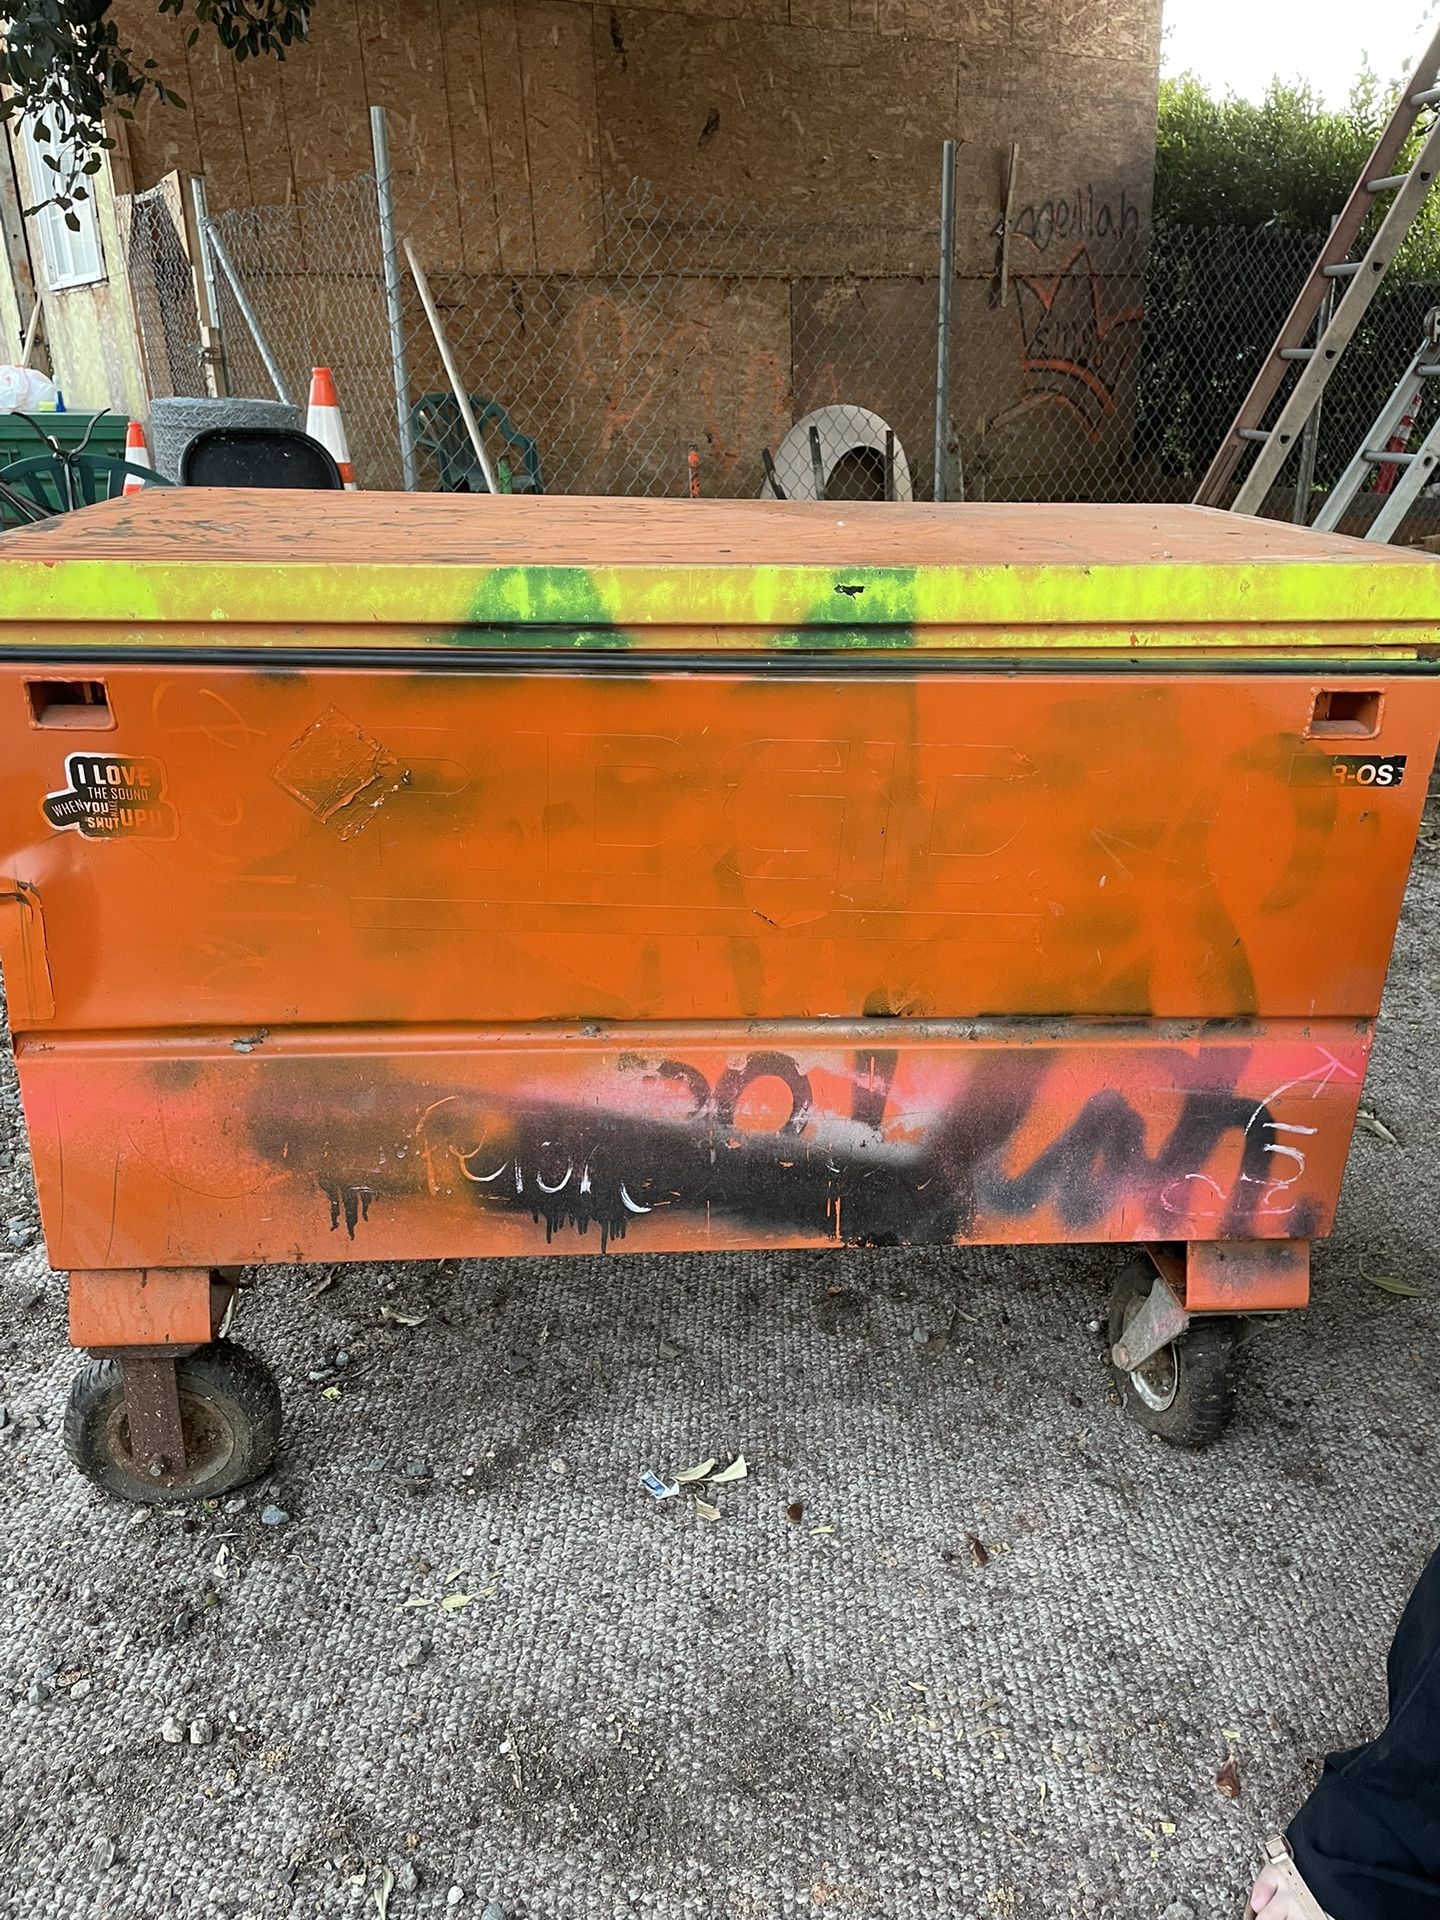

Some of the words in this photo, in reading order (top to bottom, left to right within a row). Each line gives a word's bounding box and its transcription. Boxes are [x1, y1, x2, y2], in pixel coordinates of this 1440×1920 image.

[77, 764, 86, 784] I
[93, 764, 150, 786] LOVE
[87, 787, 108, 799] THE
[111, 788, 148, 801] SOUND
[51, 799, 84, 817] WHEN
[82, 801, 109, 814] YOU
[86, 817, 119, 830] SHUT
